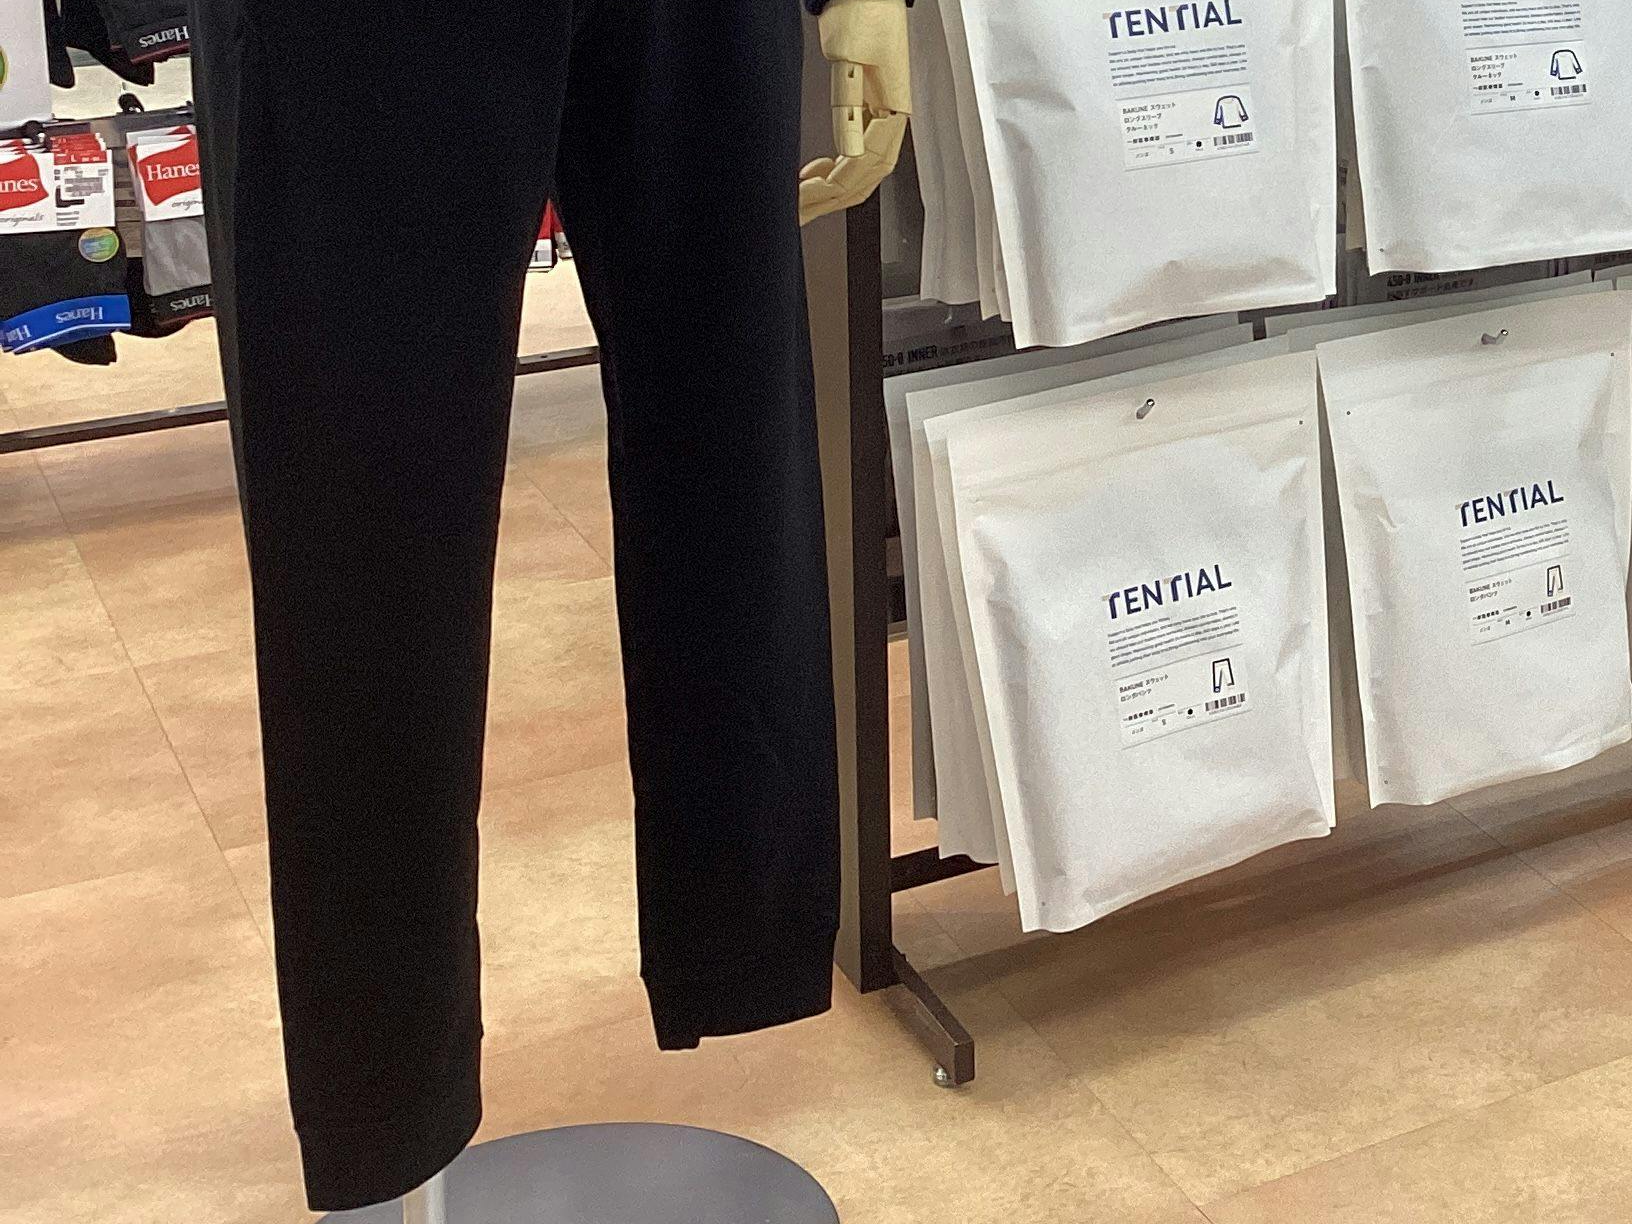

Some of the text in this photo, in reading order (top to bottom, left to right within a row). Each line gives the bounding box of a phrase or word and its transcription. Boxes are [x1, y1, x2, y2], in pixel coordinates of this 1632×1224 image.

[1103, 0, 1242, 38] TENTIAL
[139, 25, 189, 47] Hanes
[1122, 106, 1148, 115] BAKUNE
[56, 306, 103, 323] Hanes
[1455, 480, 1564, 527] TENTIAL
[1102, 564, 1232, 619] TENTIAL
[1119, 681, 1143, 693] BAKUNE
